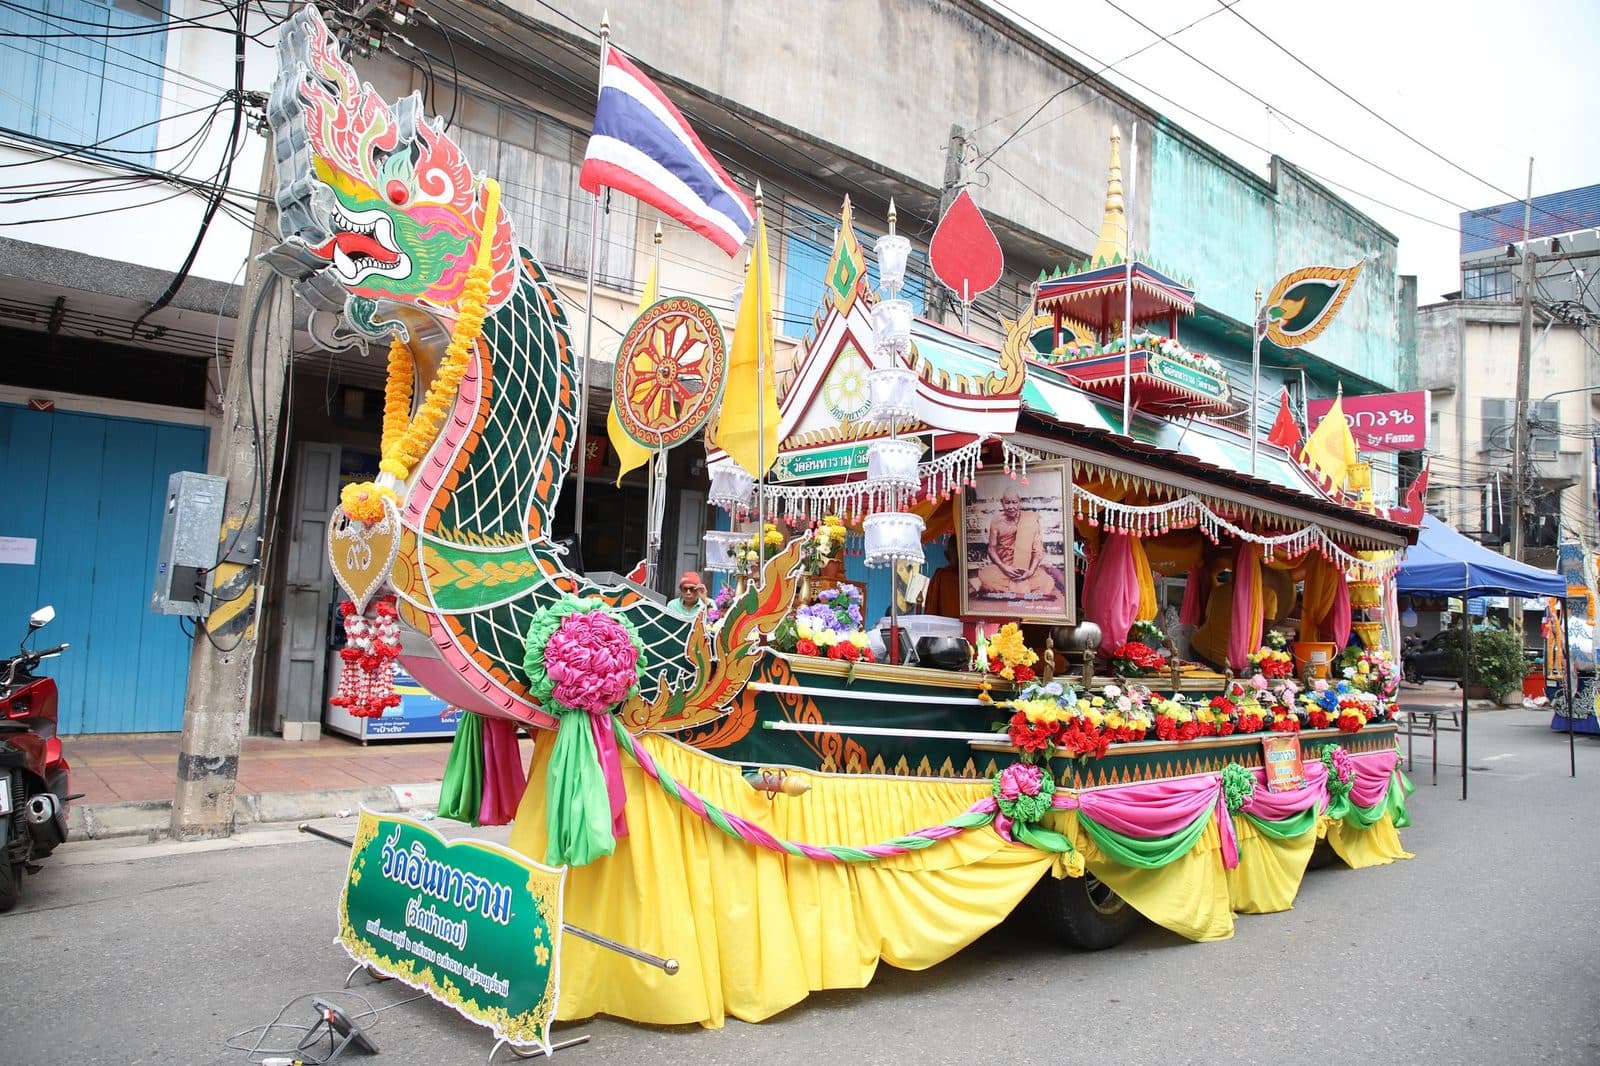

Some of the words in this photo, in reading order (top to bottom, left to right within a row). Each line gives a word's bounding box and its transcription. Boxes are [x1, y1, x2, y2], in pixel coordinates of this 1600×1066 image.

[1367, 433, 1382, 447] by
[1385, 432, 1416, 444] Fame
[792, 456, 852, 473] วัดอินทาราม
[383, 825, 511, 924] วัดอินทาราม
[405, 893, 468, 951] (วัดท่าเคย)
